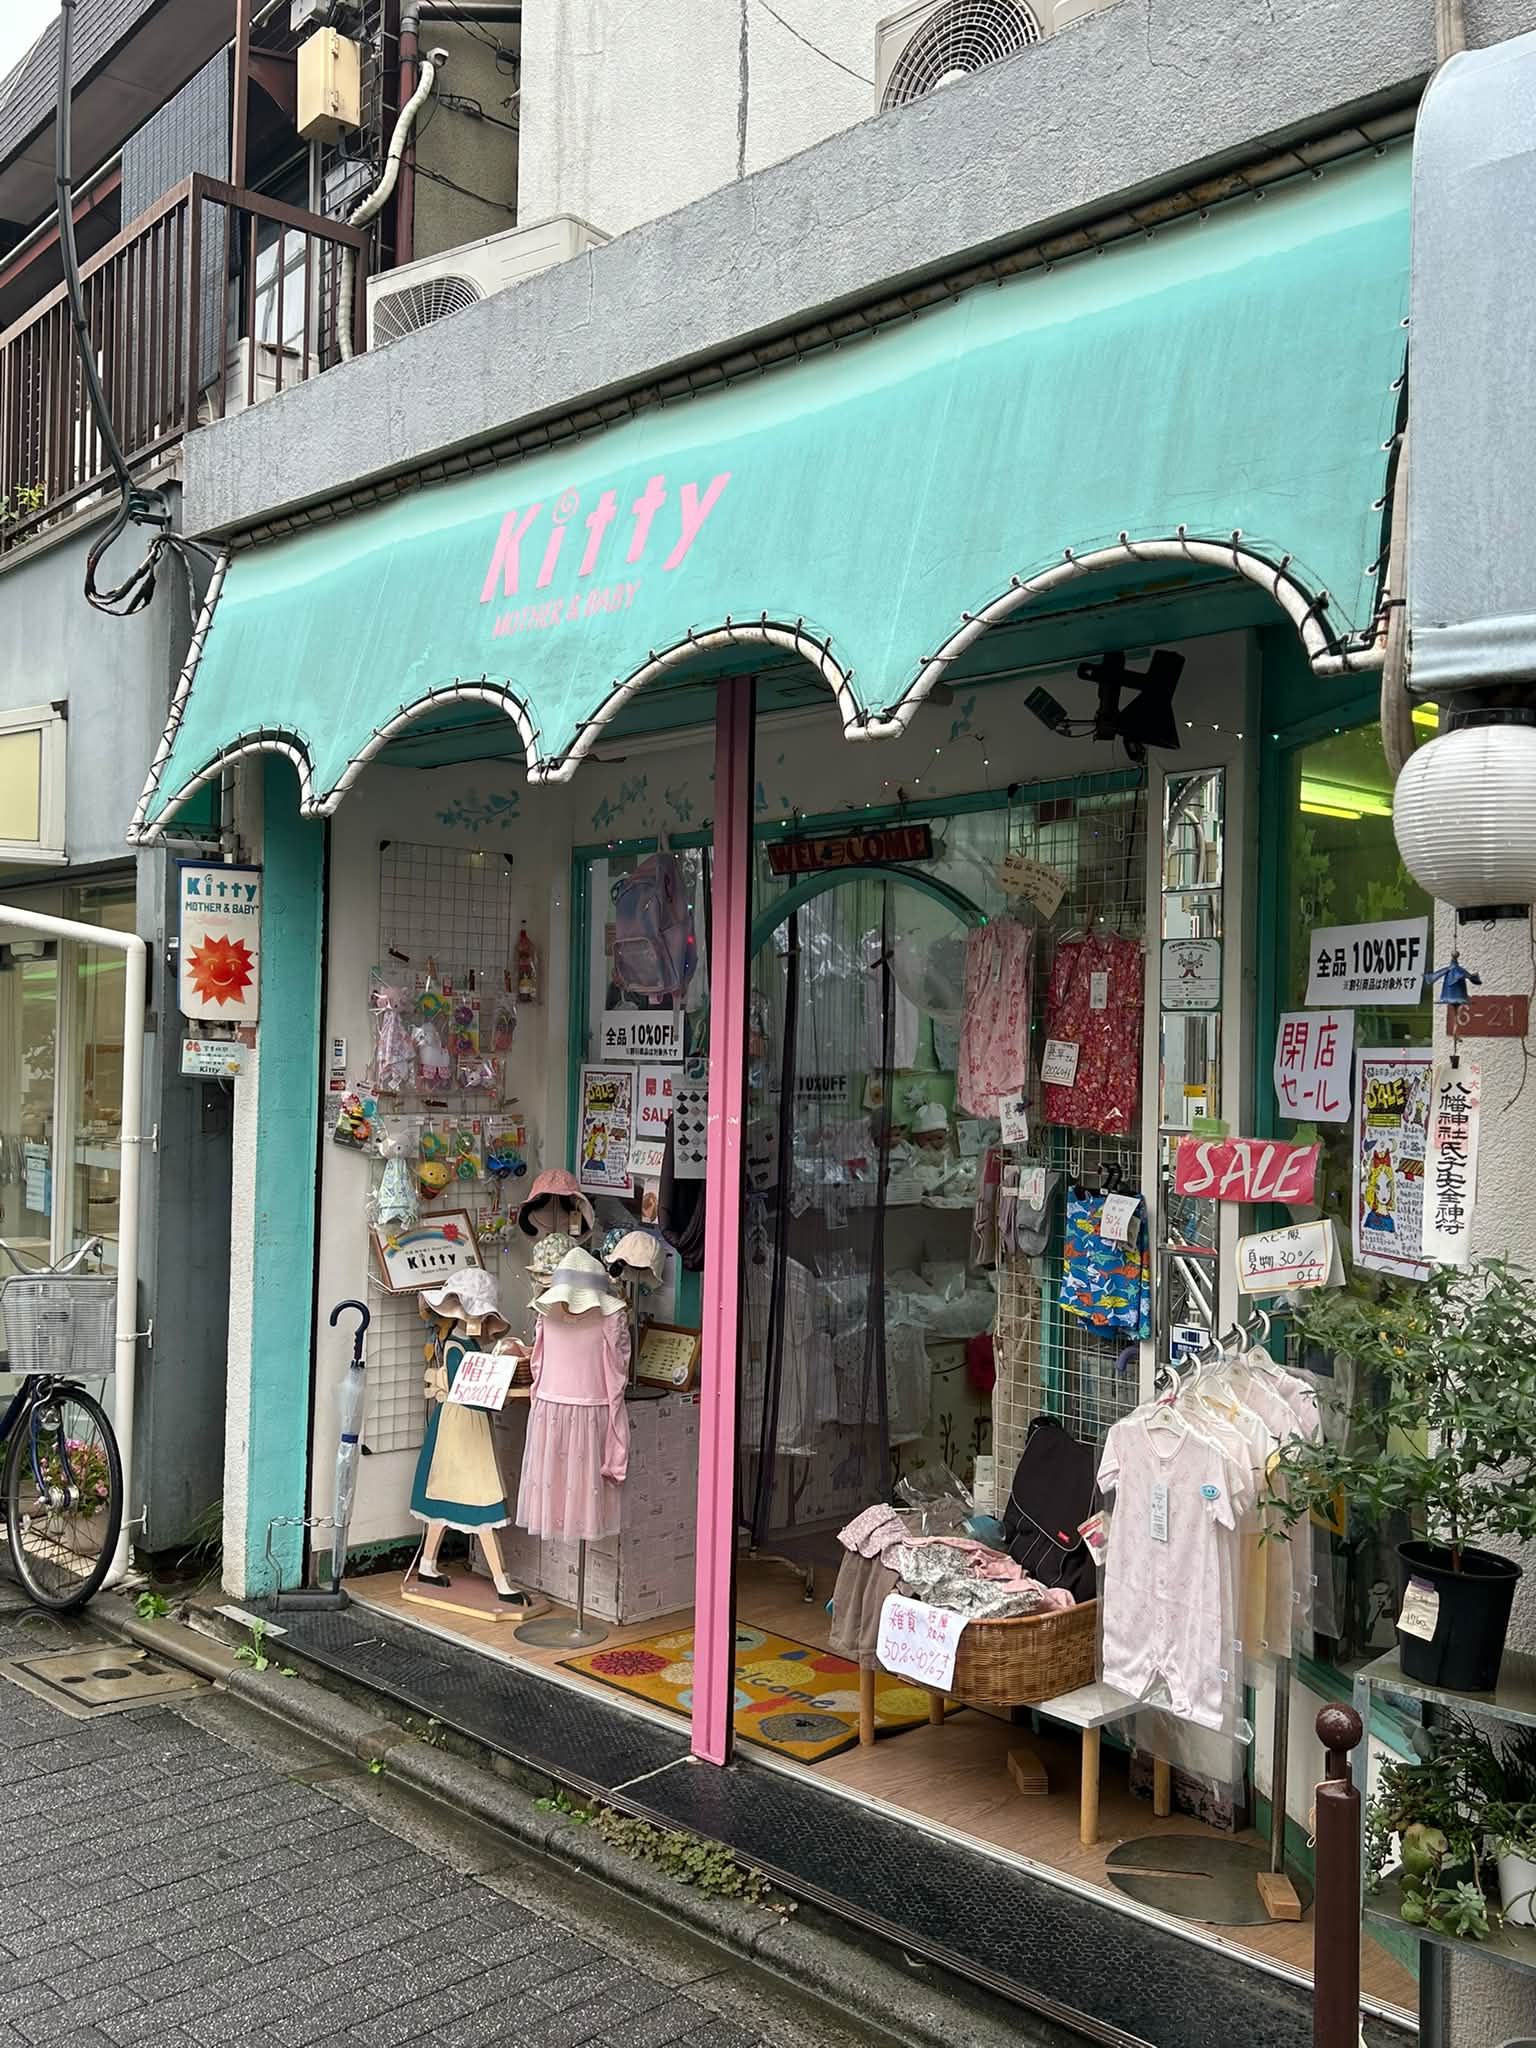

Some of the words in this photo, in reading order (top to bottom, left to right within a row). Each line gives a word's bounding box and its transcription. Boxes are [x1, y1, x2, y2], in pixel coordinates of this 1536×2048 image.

[480, 472, 732, 604] Kitty
[492, 599, 564, 640] MOTHER
[566, 594, 581, 621] &
[584, 580, 641, 616] BABY
[771, 828, 926, 873] WELCOME
[187, 874, 257, 902] Kitty
[186, 902, 222, 912] MOTHER
[223, 903, 231, 913] &
[232, 903, 256, 914] BABY
[1317, 949, 1346, 977] 全品
[1353, 937, 1420, 974] 10%OFF
[1457, 1004, 1514, 1027] 6-21
[606, 1027, 627, 1046] 全品
[1280, 1015, 1338, 1072] 閉店
[1281, 1074, 1339, 1112] セール
[1366, 1078, 1406, 1109] SALE
[1183, 1142, 1312, 1198] SALE
[407, 1253, 456, 1270] Kitty
[1279, 1250, 1316, 1266] 30%
